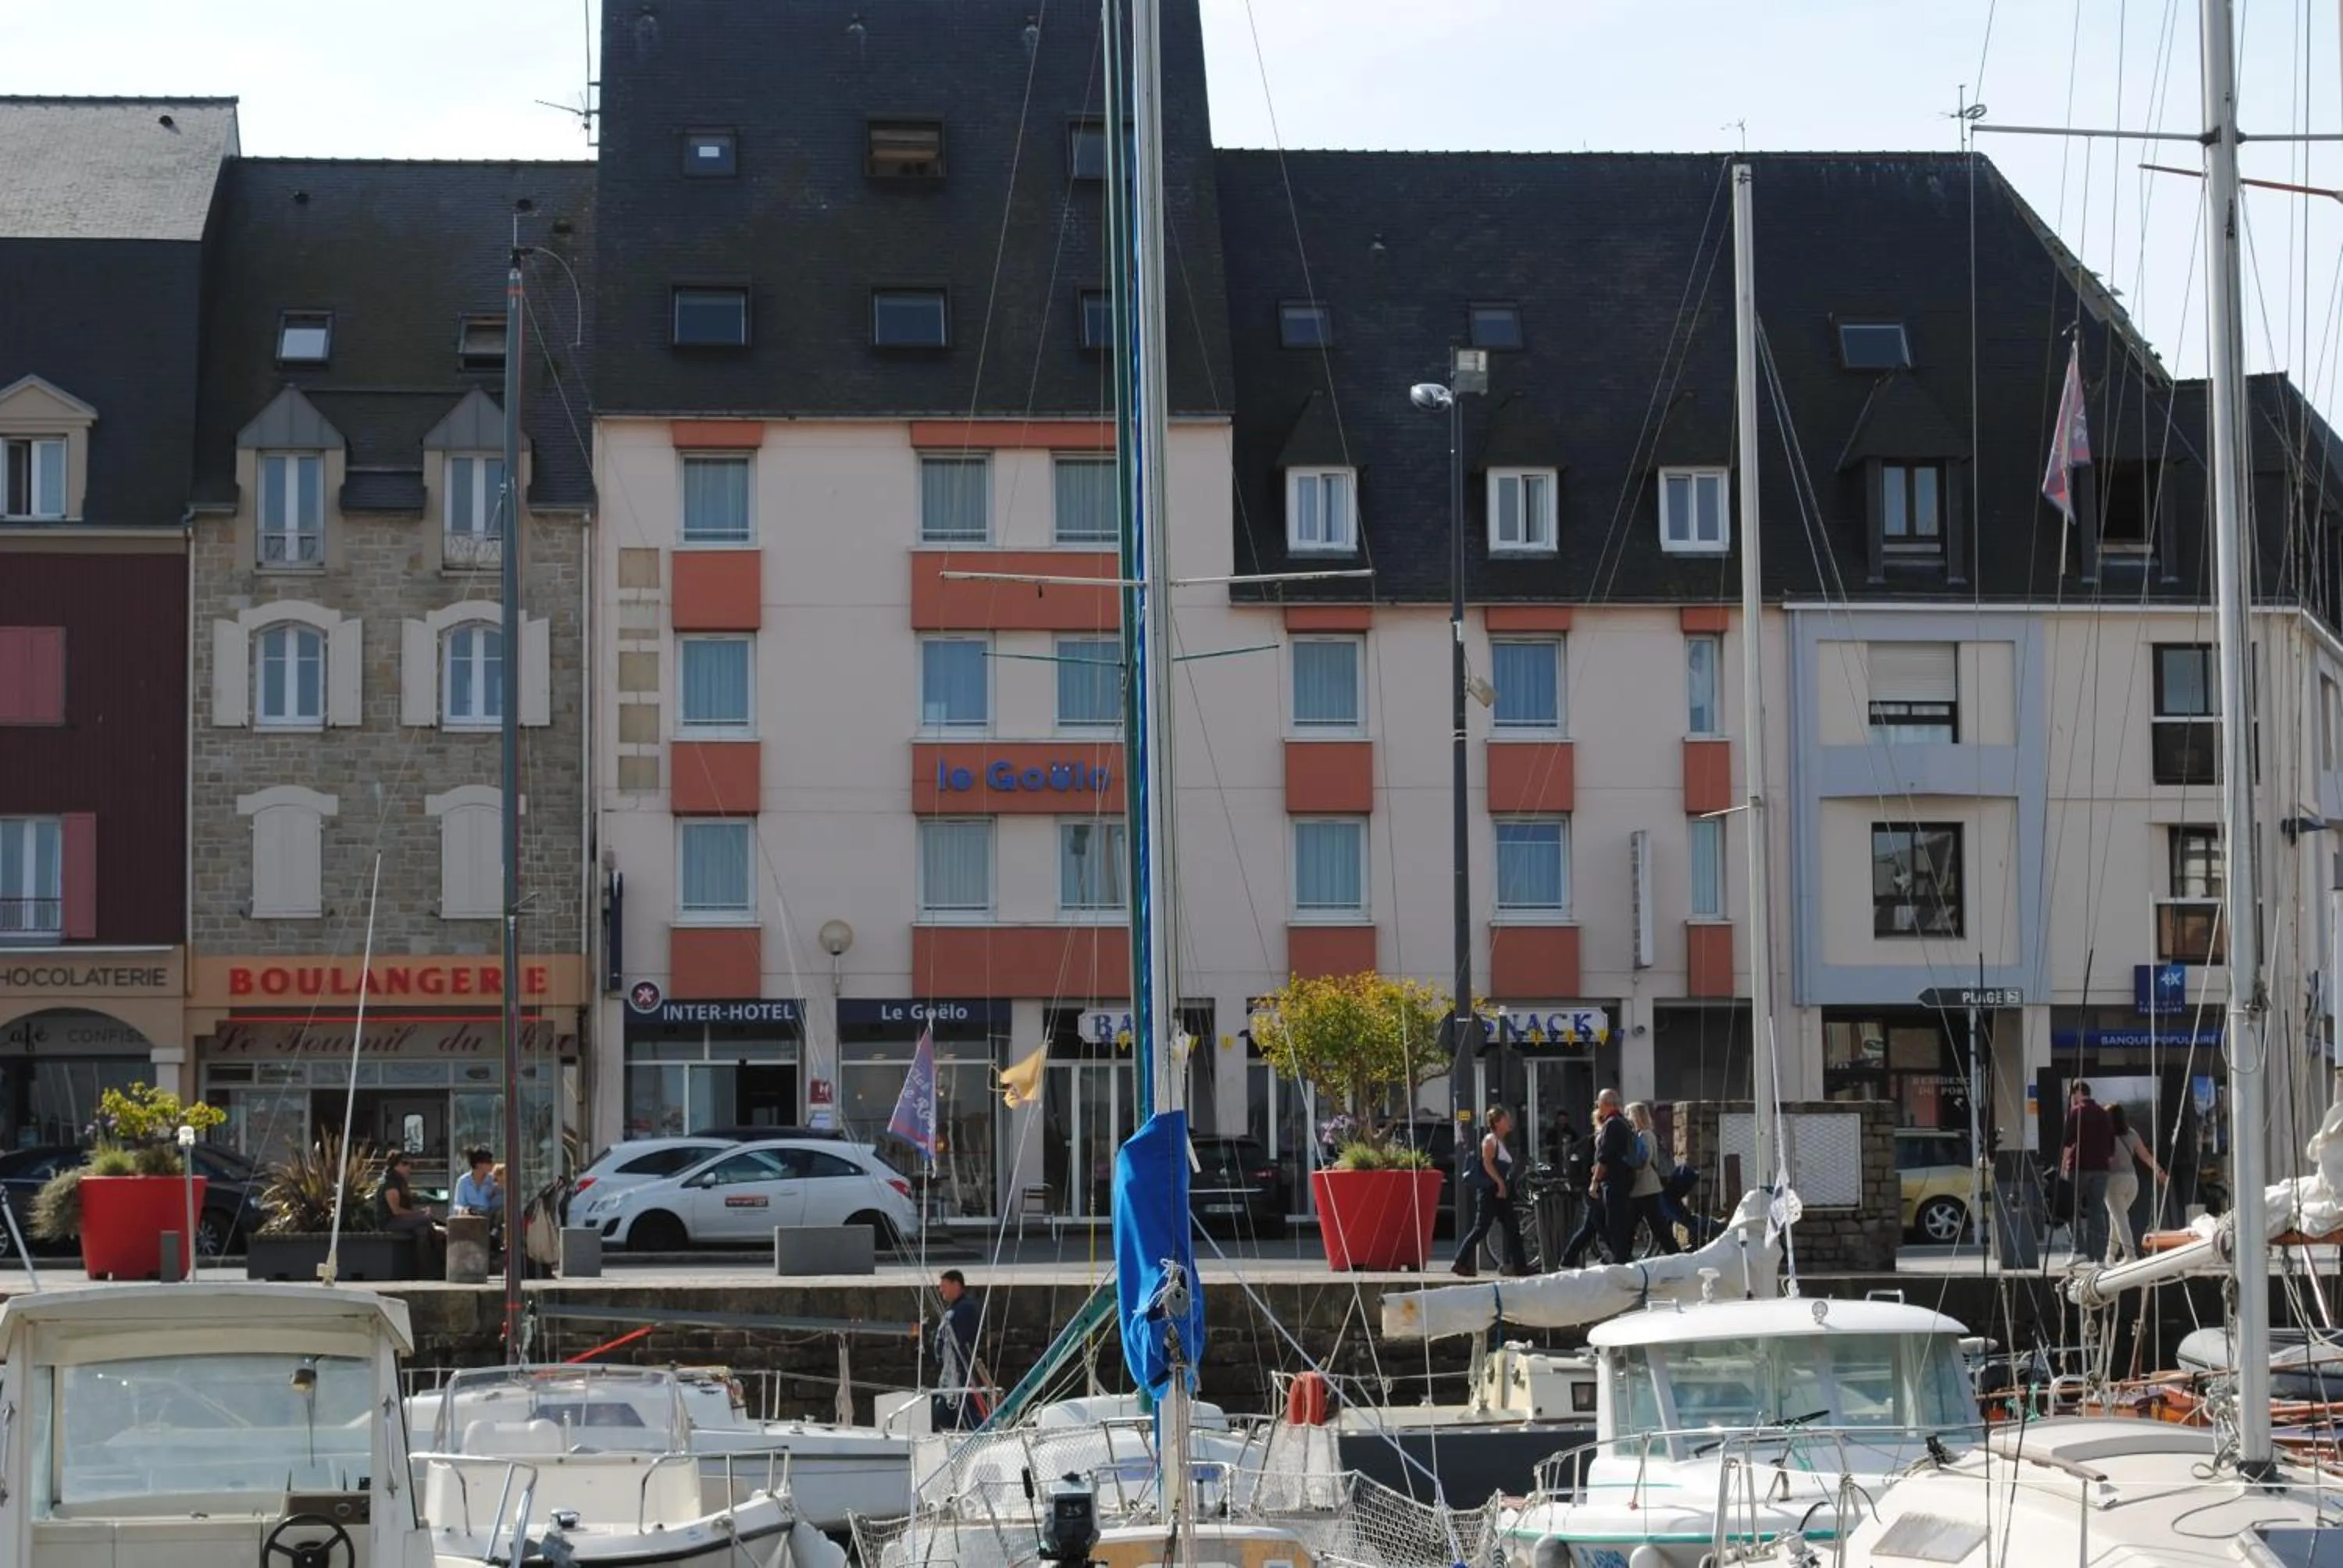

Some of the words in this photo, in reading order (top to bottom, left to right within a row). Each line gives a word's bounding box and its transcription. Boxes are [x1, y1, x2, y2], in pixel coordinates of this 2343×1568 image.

[228, 967, 547, 996] BOULANGERE
[1962, 992, 2003, 1003] PLAGE
[663, 1003, 795, 1021] INTER-HOTEL
[881, 1004, 903, 1020] Le
[910, 1003, 968, 1020] Goëlo
[1094, 1014, 1132, 1037] BA
